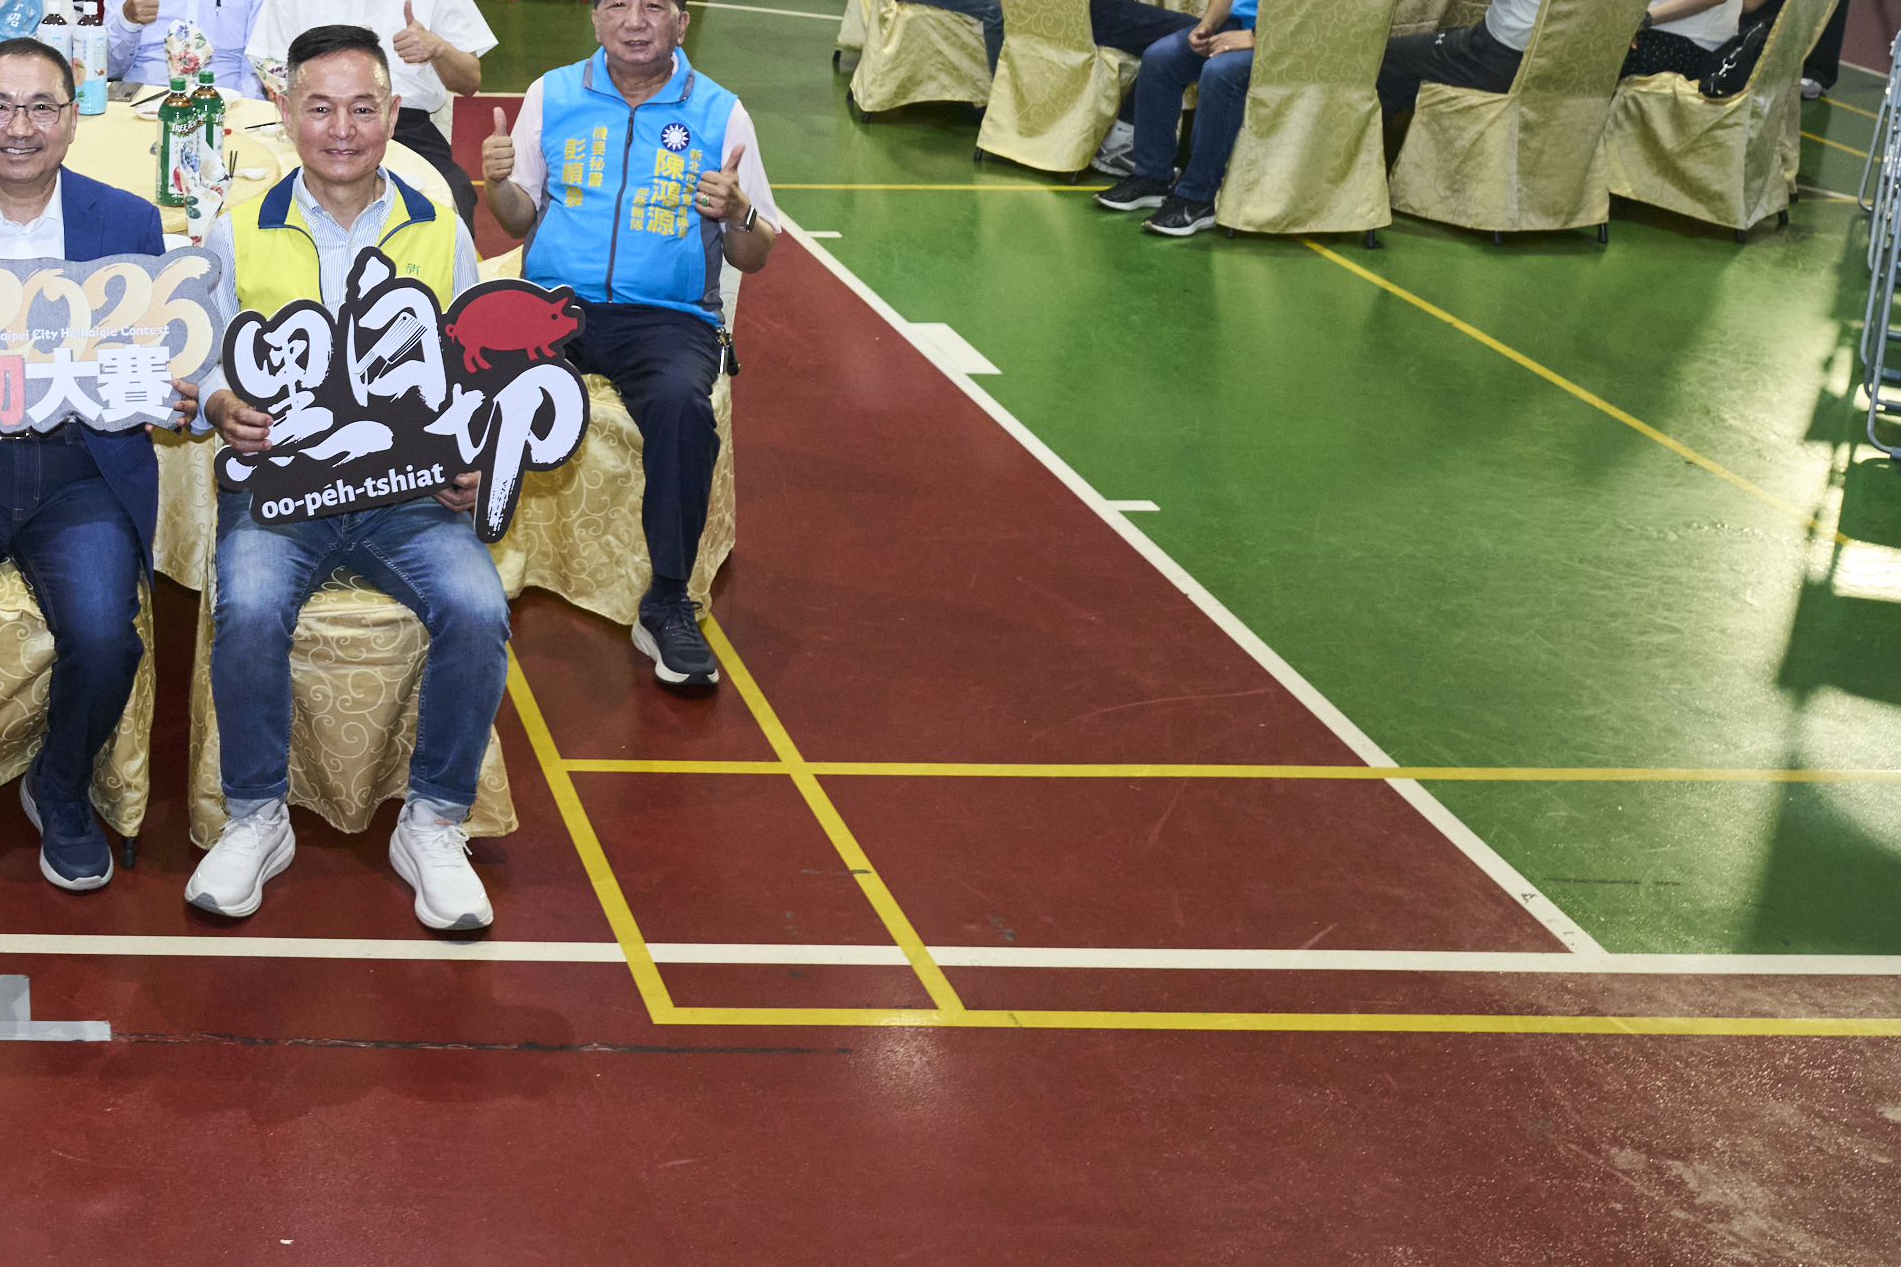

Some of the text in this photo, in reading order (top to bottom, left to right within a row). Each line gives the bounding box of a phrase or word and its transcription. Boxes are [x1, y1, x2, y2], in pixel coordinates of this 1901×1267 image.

[562, 138, 586, 207] 彭順發
[588, 126, 608, 187] 機要秘書
[647, 148, 685, 236] 陳鴻源
[32, 328, 58, 341] City
[121, 325, 170, 337] Contest
[261, 463, 446, 519] oo-péh-tshiat
